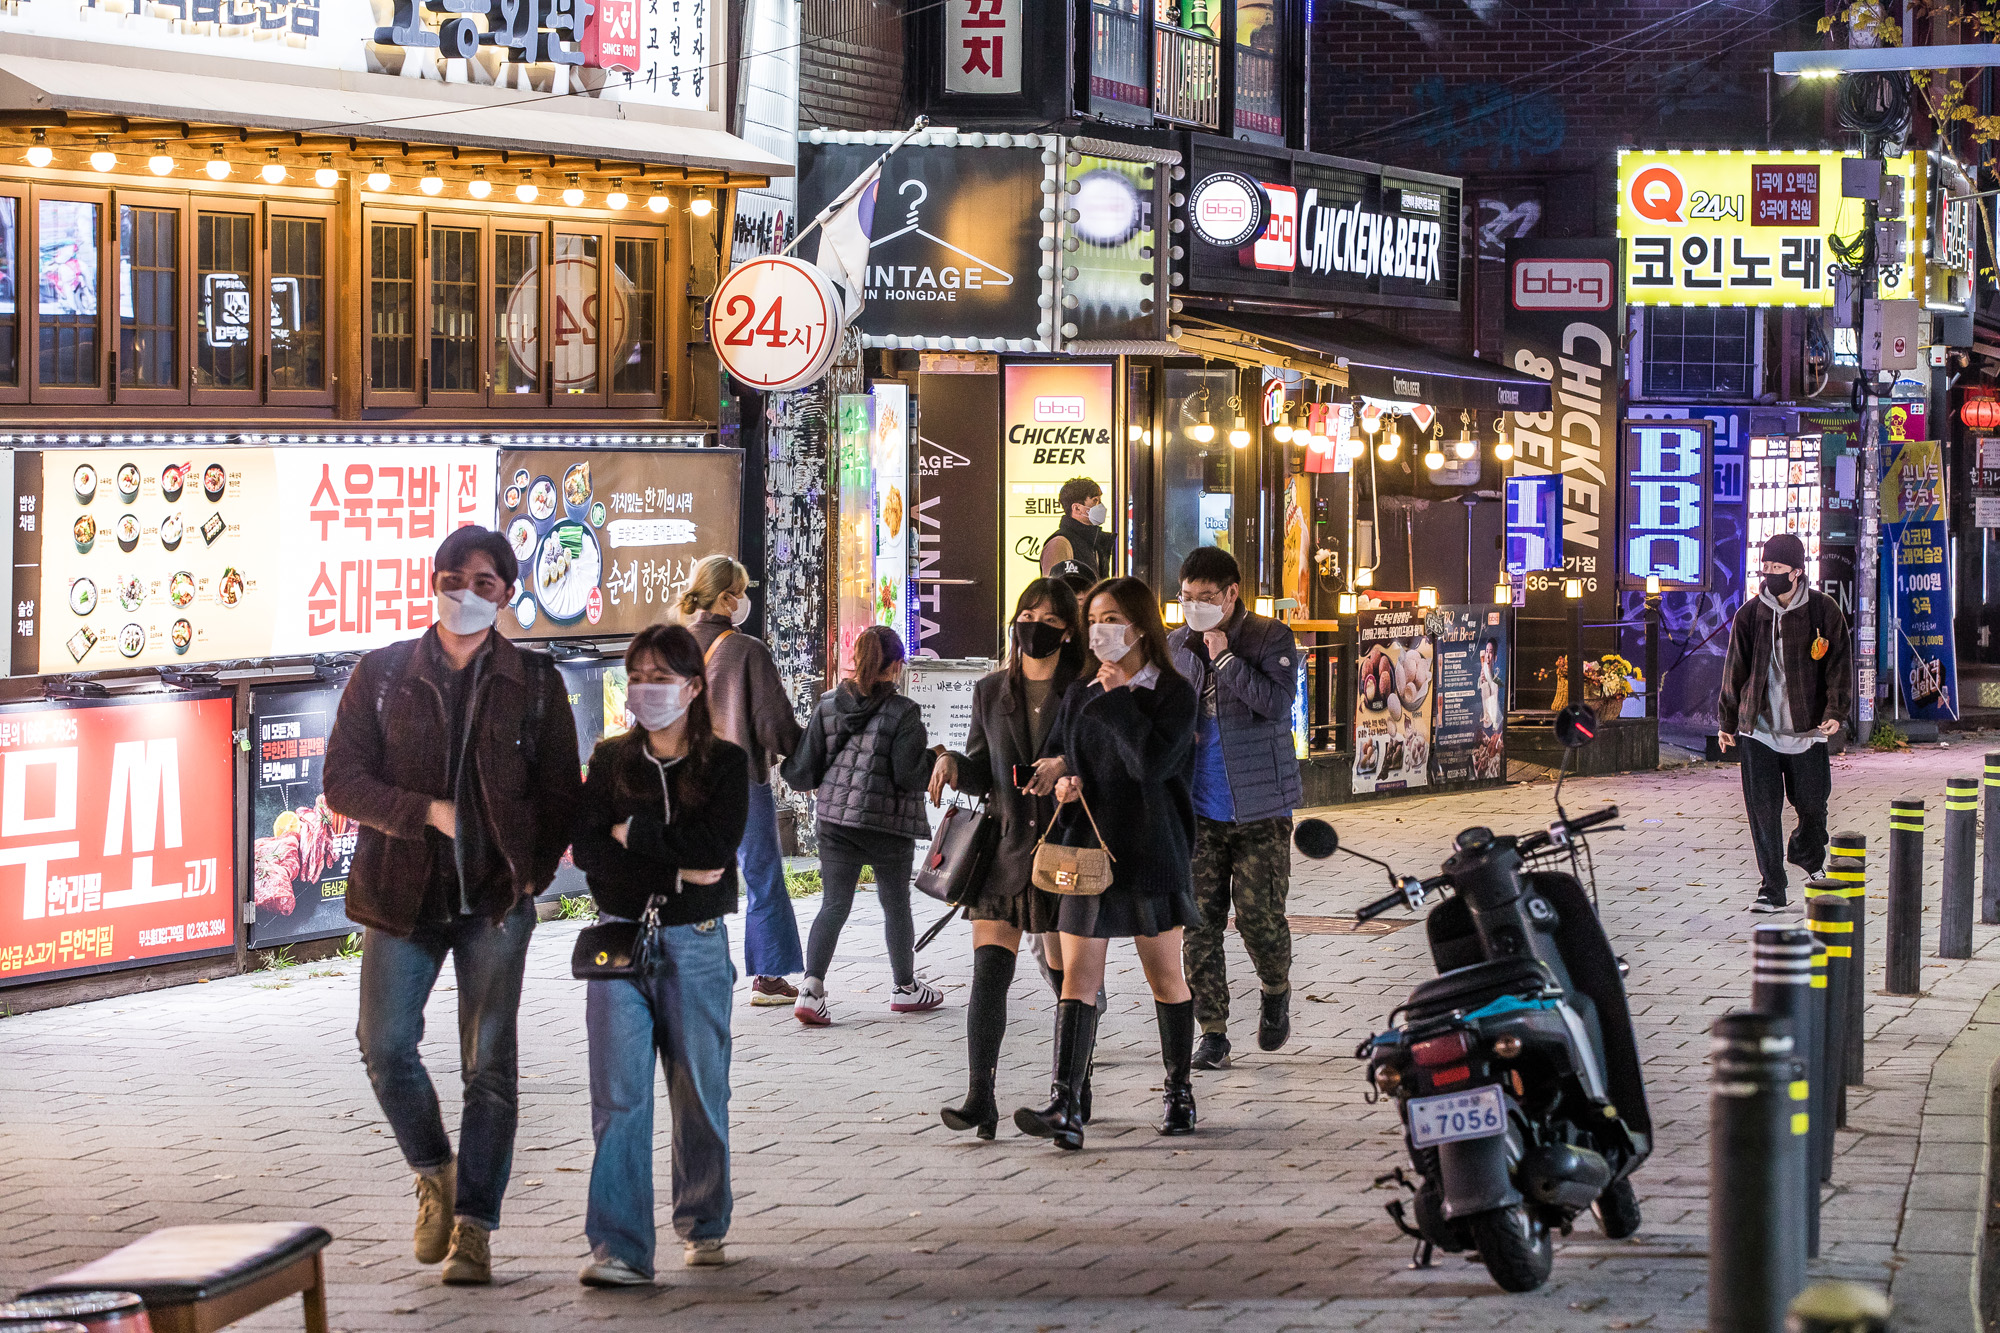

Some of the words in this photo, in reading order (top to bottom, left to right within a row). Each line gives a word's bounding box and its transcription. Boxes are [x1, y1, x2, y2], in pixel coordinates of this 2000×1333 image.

[602, 42, 621, 56] SINCE
[1755, 172, 1783, 194] 1곡에
[1785, 173, 1817, 194] 오백원
[1690, 191, 1744, 221] 24시
[1760, 199, 1788, 221] 3곡에
[1790, 199, 1812, 221] 천원
[864, 265, 982, 290] INTAGE
[885, 290, 956, 302] HONGDAE
[724, 294, 812, 354] 24시
[1559, 322, 1612, 550] CHICKEN
[1033, 447, 1086, 466] BEER
[19, 495, 36, 513] 밥상
[310, 464, 440, 541] 수육국밥
[610, 492, 644, 514] 가치있는
[676, 492, 693, 513] 시작
[1630, 427, 1701, 583] BBQ
[19, 515, 36, 532] 차림
[1205, 516, 1229, 530] Hoeg
[606, 559, 638, 605] 순대
[641, 556, 698, 605] 항정수
[911, 496, 941, 659] VINTA
[1898, 573, 1942, 594] 1,000원
[308, 556, 434, 636] 순대국밥
[1912, 597, 1931, 615] 3곡
[17, 600, 34, 617] 술상
[17, 620, 34, 637] 차림
[0, 722, 20, 747] 문의
[262, 739, 297, 761] 무한리필
[0, 946, 24, 971] 상급
[24, 940, 56, 967] 소고기
[58, 925, 114, 962] 무한리필
[1435, 1107, 1498, 1135] 7056
